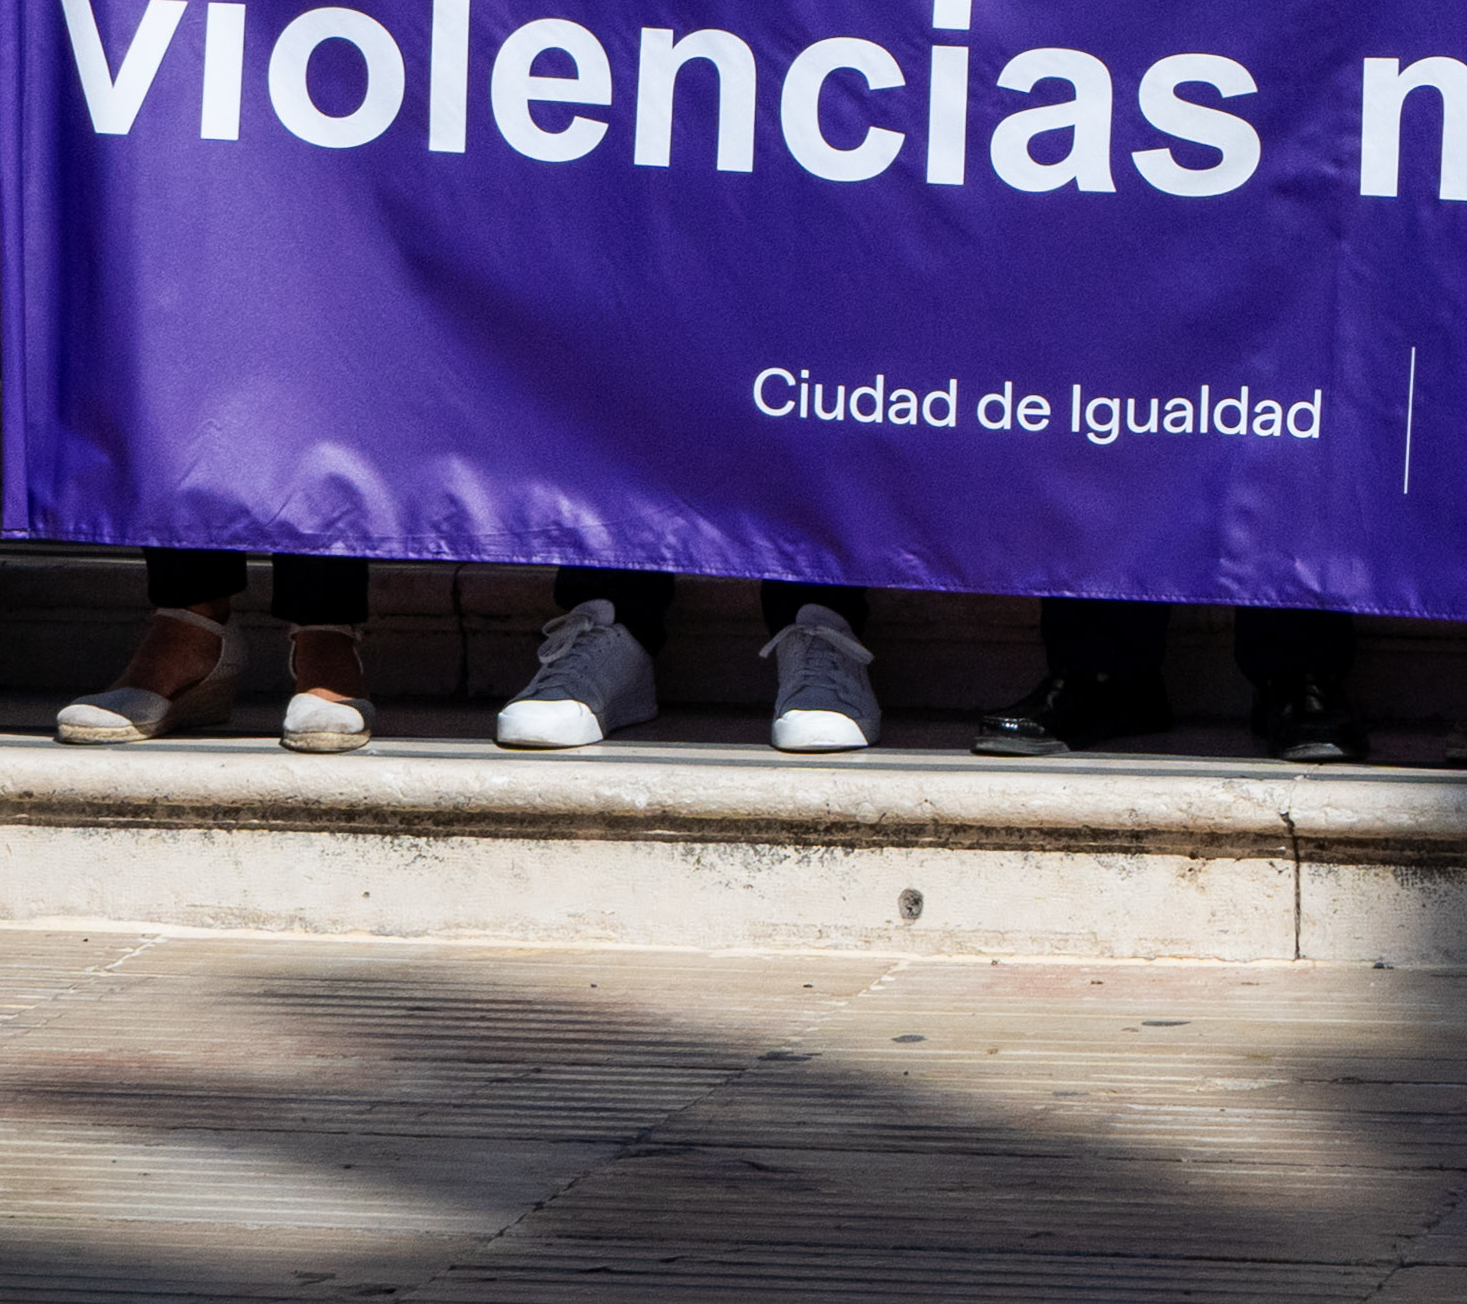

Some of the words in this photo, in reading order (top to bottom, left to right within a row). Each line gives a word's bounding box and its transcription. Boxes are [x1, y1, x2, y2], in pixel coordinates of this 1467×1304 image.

[752, 366, 958, 428] Ciudad
[977, 380, 1052, 432] de
[1071, 383, 1323, 446] Igualdad
